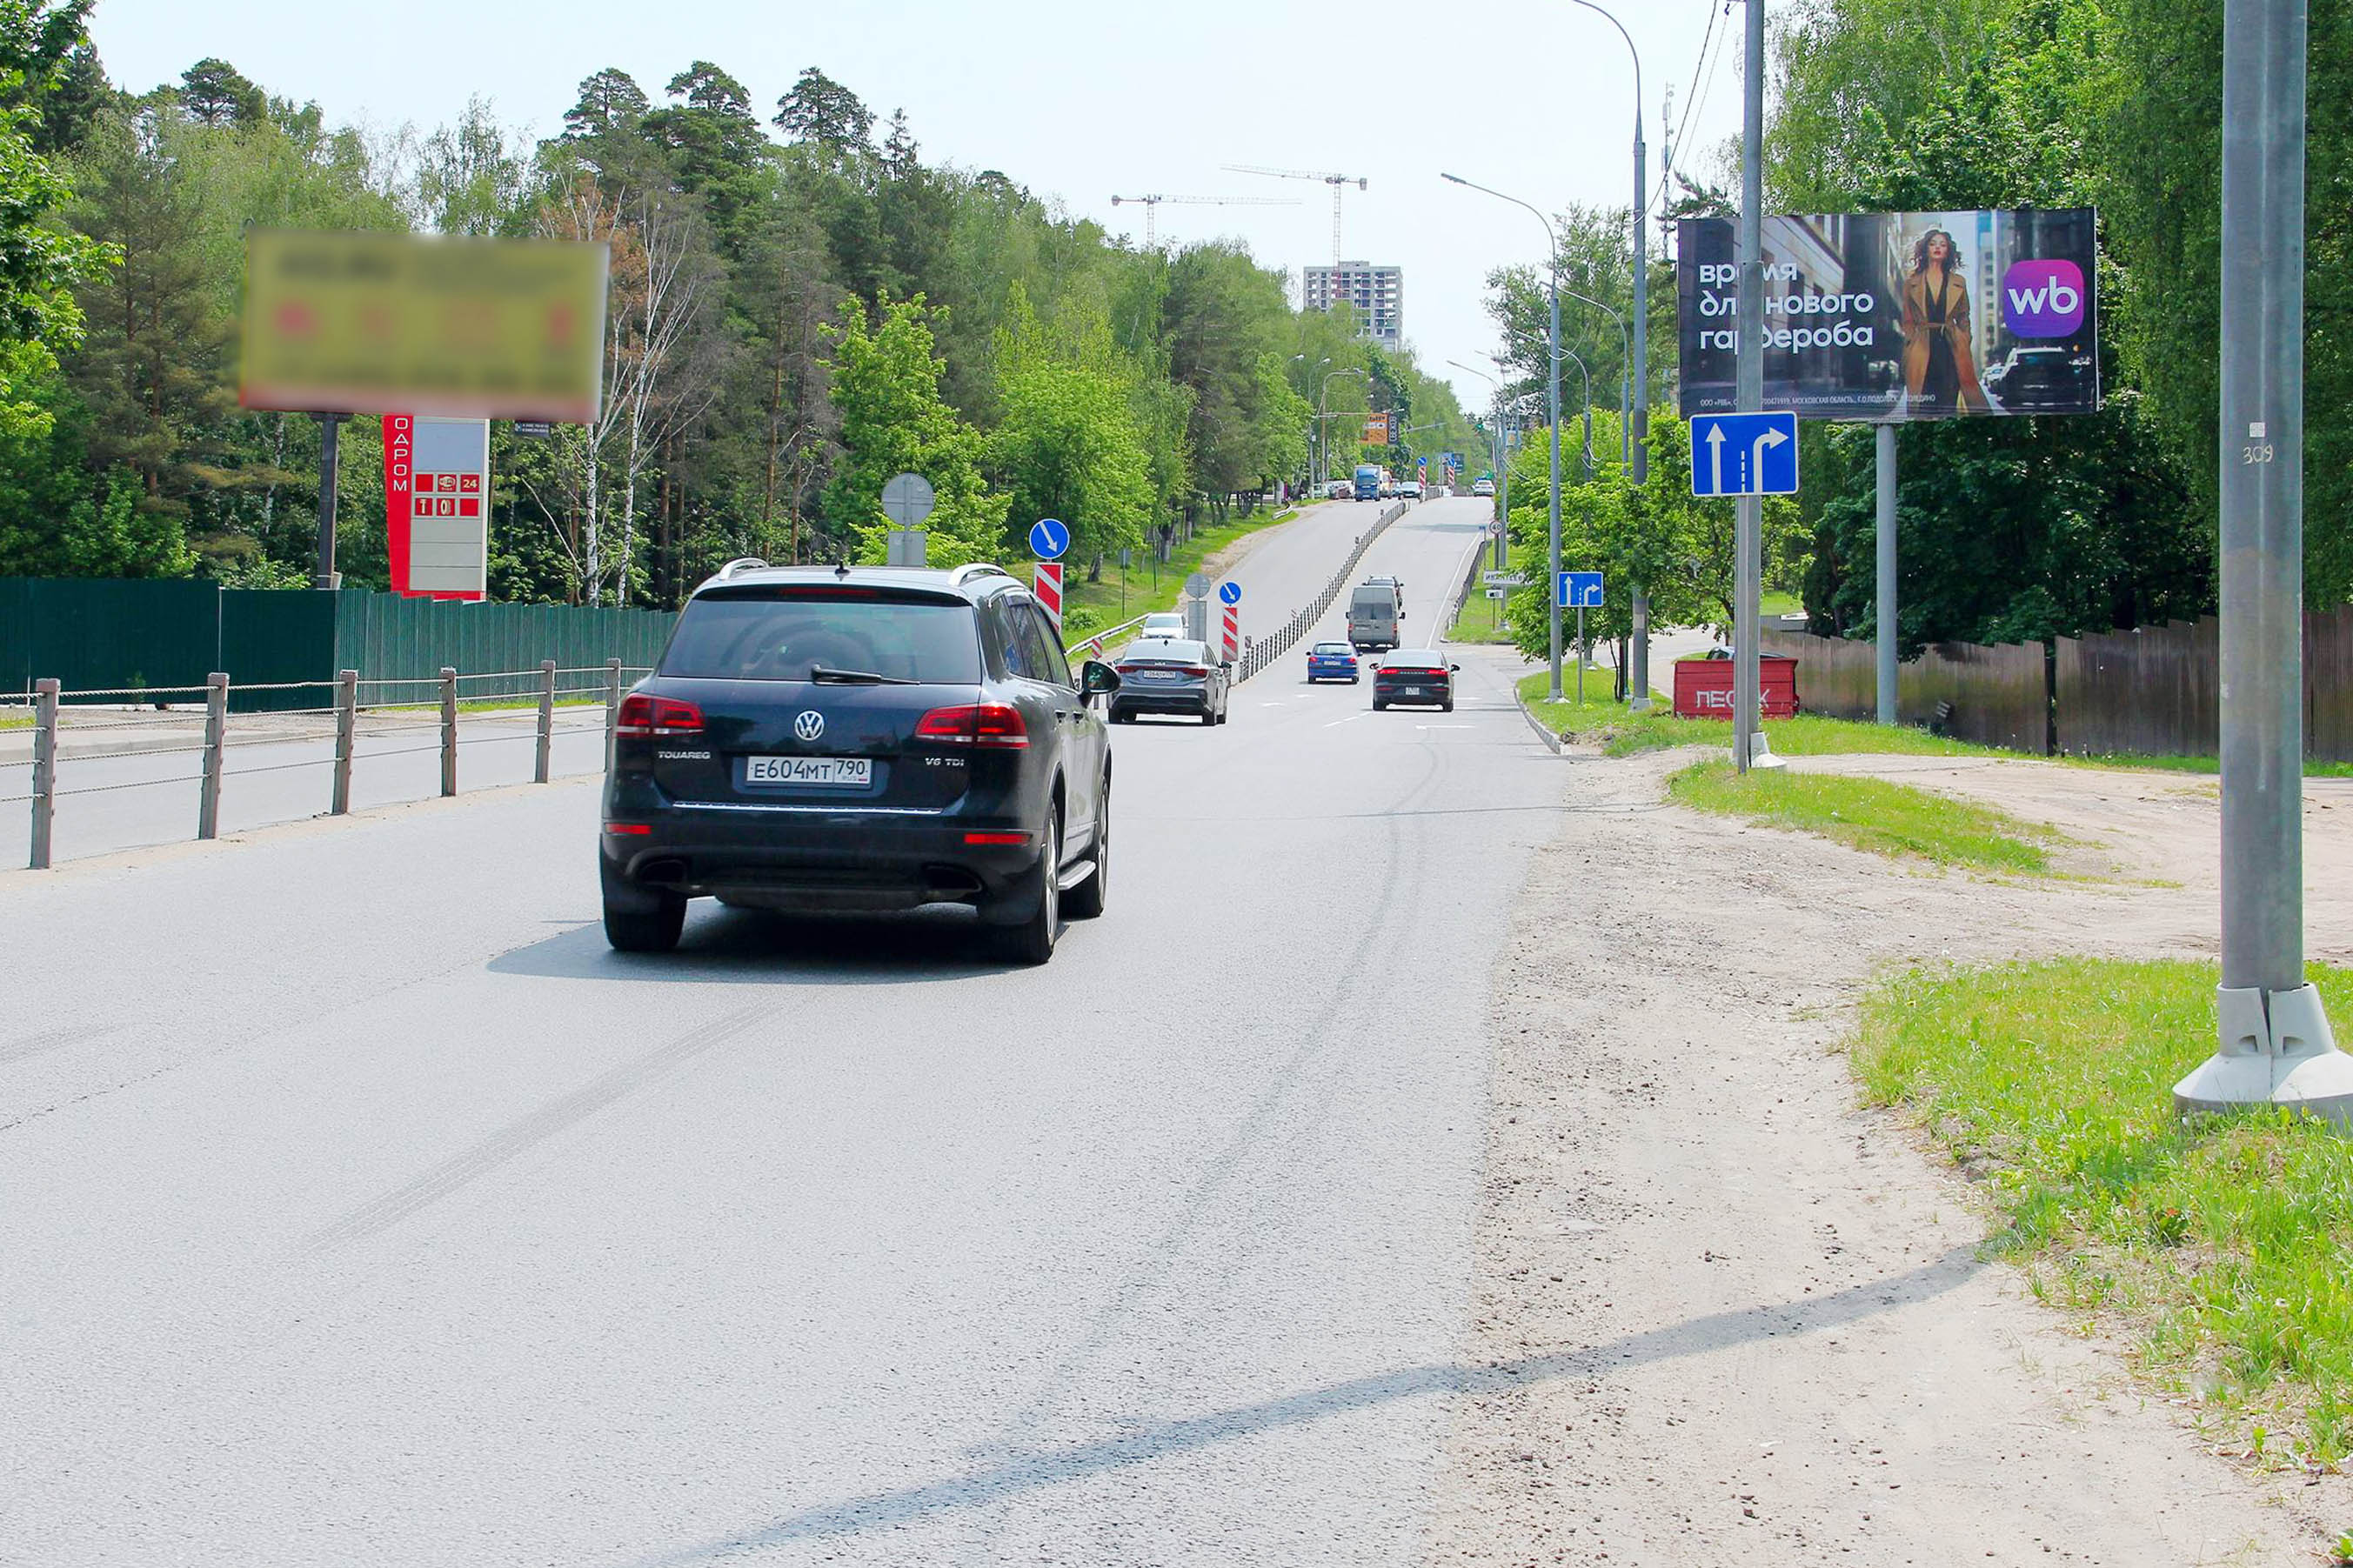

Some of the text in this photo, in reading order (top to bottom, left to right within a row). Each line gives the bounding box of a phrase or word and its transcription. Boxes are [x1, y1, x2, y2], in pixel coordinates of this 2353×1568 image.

[1699, 263, 1798, 289] врмя
[1699, 290, 1874, 317] дл нового
[2008, 276, 2079, 315] wb
[2243, 444, 2274, 465] 309
[463, 479, 478, 488] 24
[1695, 689, 1770, 708] ПЕСК
[658, 751, 711, 759] TOUAREG
[925, 757, 941, 766] V6
